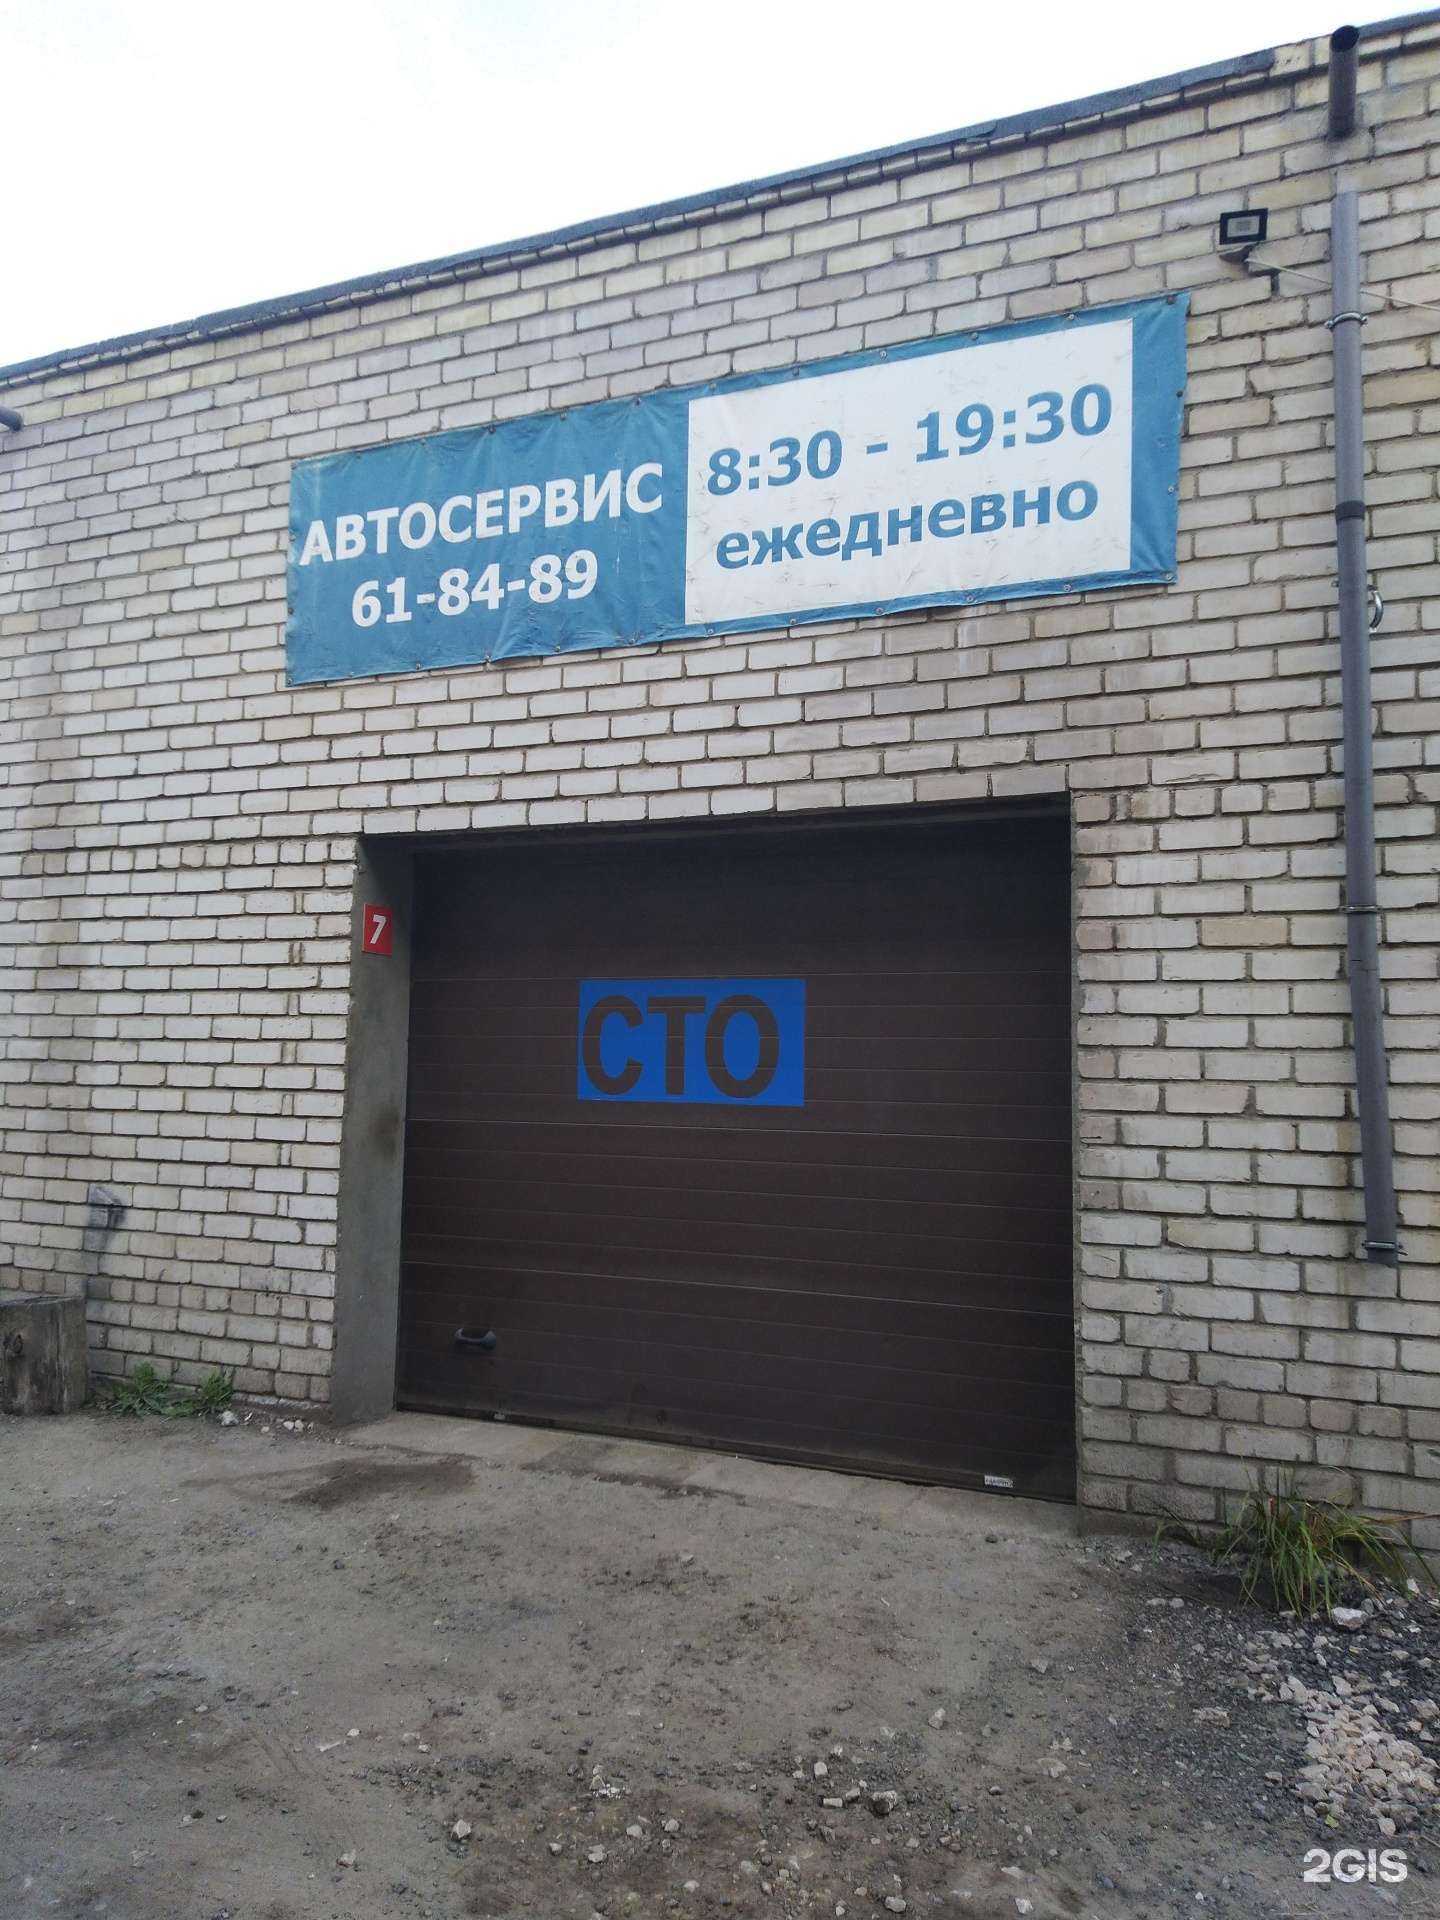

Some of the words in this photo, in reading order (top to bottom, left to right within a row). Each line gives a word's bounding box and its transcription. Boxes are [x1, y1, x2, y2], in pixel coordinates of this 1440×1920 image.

[706, 429, 843, 496] 8:30
[915, 383, 1112, 463] 19:30
[299, 462, 663, 566] АВТОСЕРВИС
[716, 480, 1099, 570] ежедневно
[351, 549, 598, 627] 61-84-89
[370, 913, 387, 945] 7
[582, 994, 781, 1099] СТО
